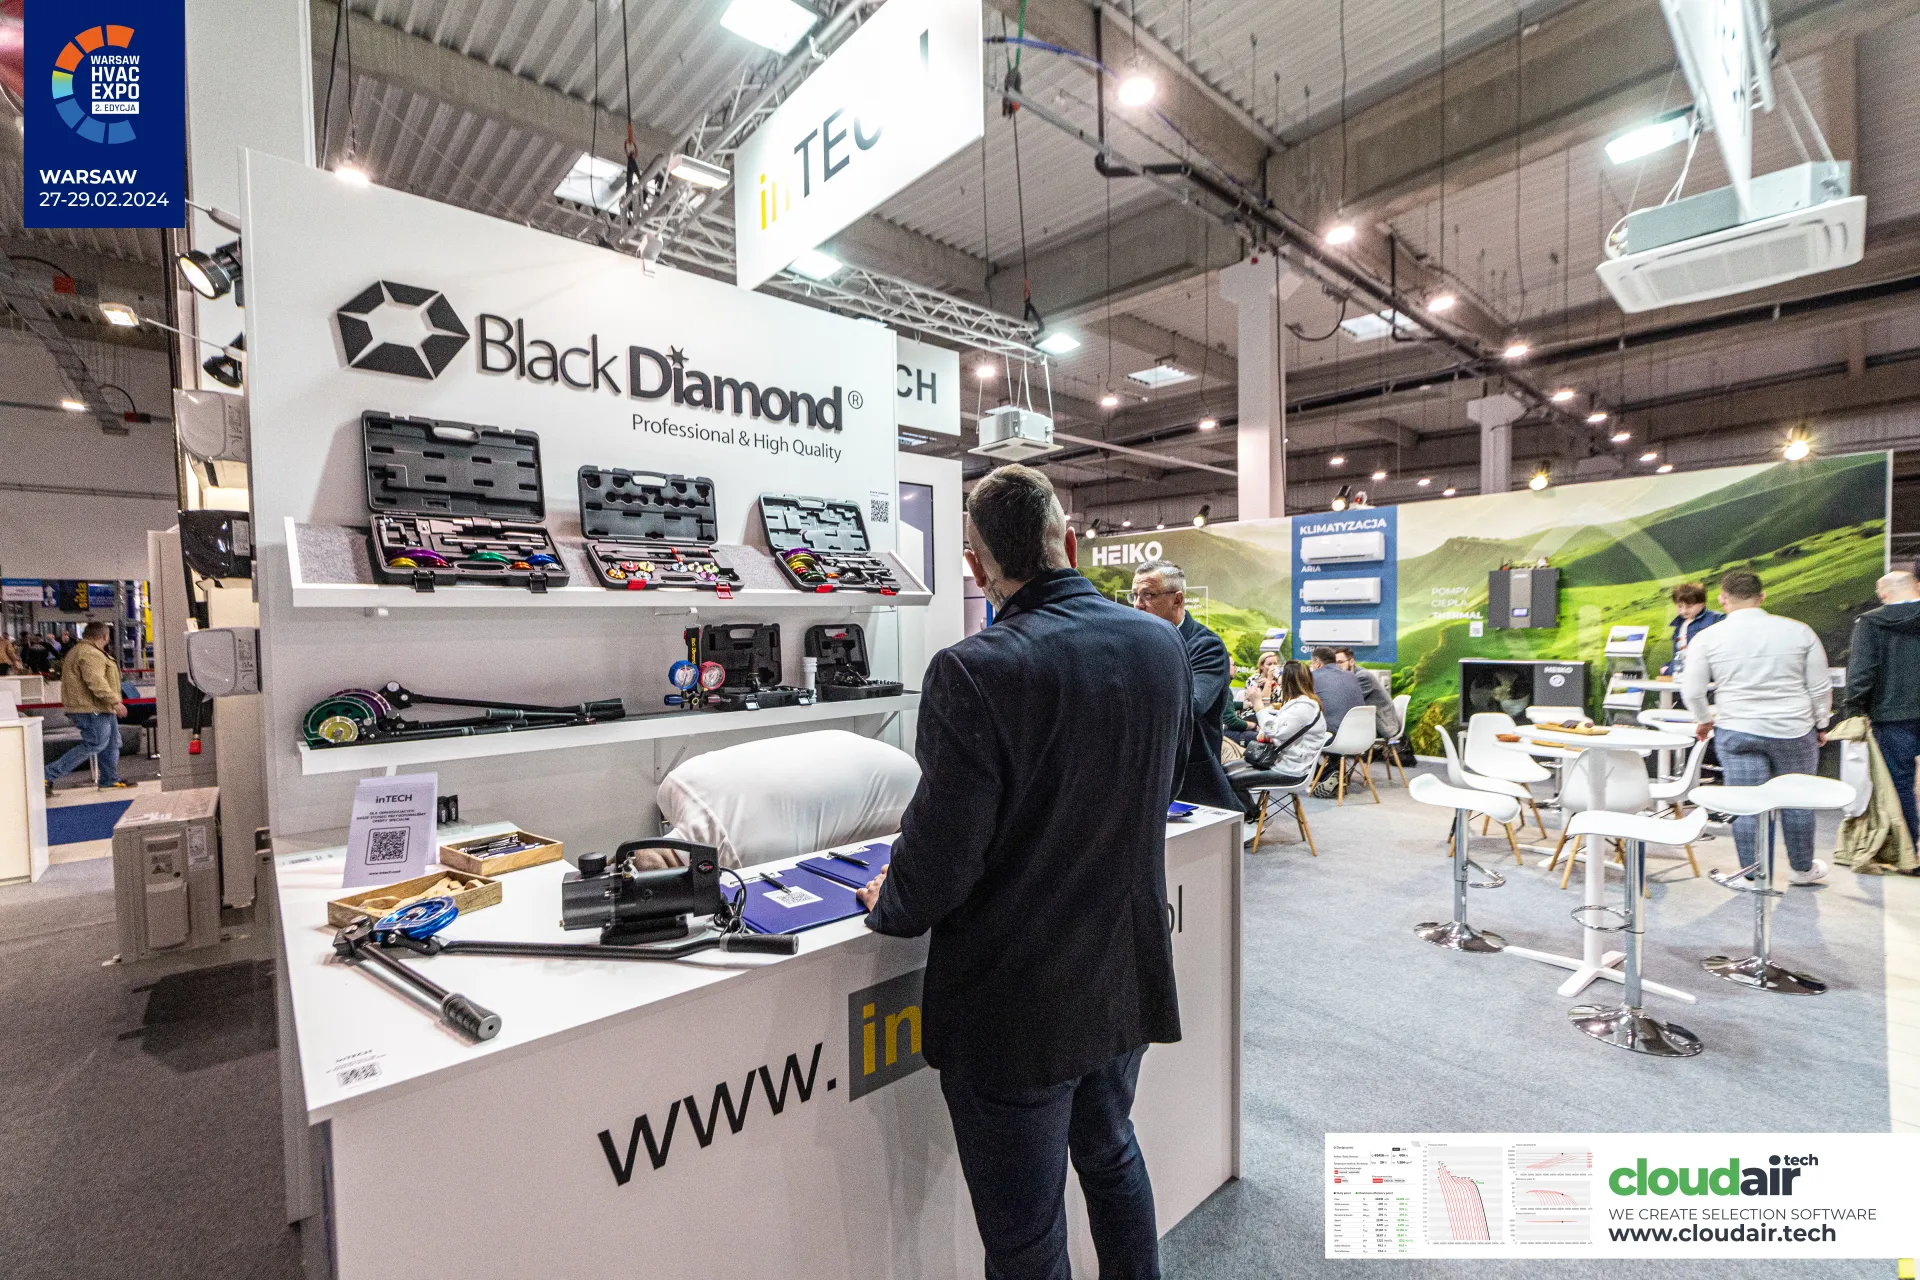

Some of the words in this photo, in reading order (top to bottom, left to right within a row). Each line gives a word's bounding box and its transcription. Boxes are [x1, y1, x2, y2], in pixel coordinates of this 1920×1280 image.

[480, 313, 622, 394] Black
[629, 345, 843, 431] Diamond
[632, 413, 734, 444] Professional
[738, 431, 750, 447] &
[754, 433, 788, 455] High
[792, 439, 842, 463] Quality
[1299, 518, 1387, 535] KLIMATYZACJA
[1092, 541, 1163, 566] HEIKO
[1301, 565, 1321, 573] ARIA
[1431, 586, 1469, 596] POMPY
[1300, 605, 1325, 613] BRISA
[1432, 611, 1483, 619] THERMAL
[375, 794, 413, 804] inTECH
